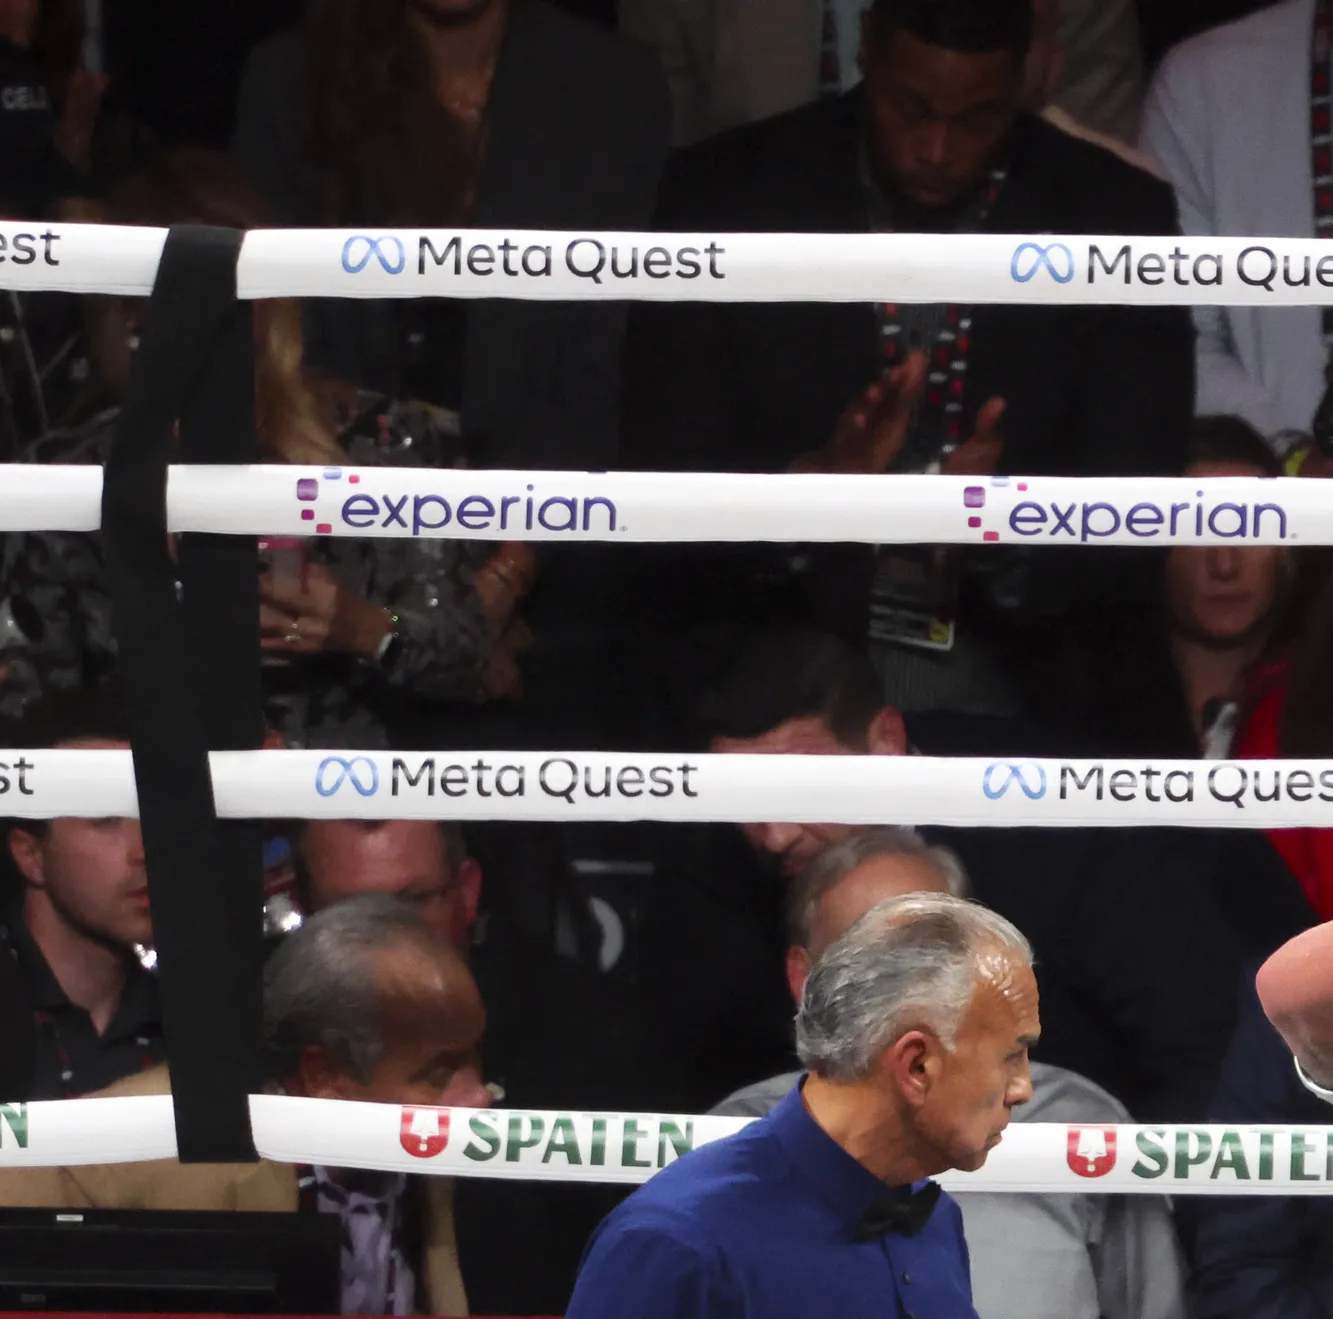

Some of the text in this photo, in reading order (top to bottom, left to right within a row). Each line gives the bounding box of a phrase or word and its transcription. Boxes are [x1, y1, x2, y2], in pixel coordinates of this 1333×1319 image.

[418, 236, 726, 284] Meta Quest
[1088, 245, 1222, 285] Meta
[341, 486, 616, 535] experian
[1009, 490, 1287, 541] experian
[392, 758, 697, 804] Meta Quest
[1060, 763, 1193, 802] Meta
[463, 1111, 694, 1168] SPATEN
